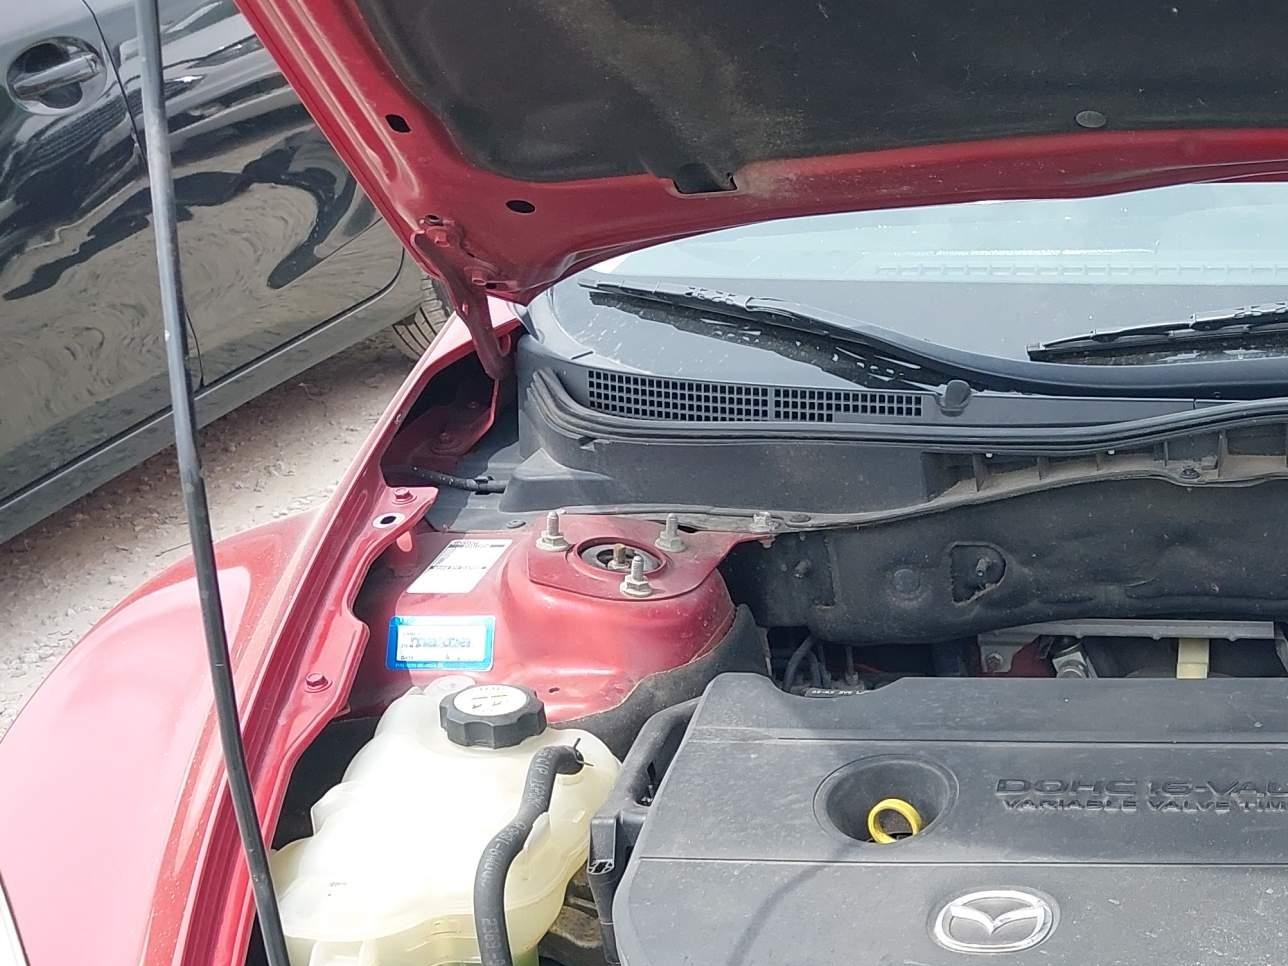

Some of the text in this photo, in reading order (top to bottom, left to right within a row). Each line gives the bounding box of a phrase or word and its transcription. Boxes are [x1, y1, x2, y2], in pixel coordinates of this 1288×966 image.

[995, 778, 1138, 798] DOHC
[1002, 799, 1137, 813] VARIABLE
[1148, 799, 1231, 815] VALVE
